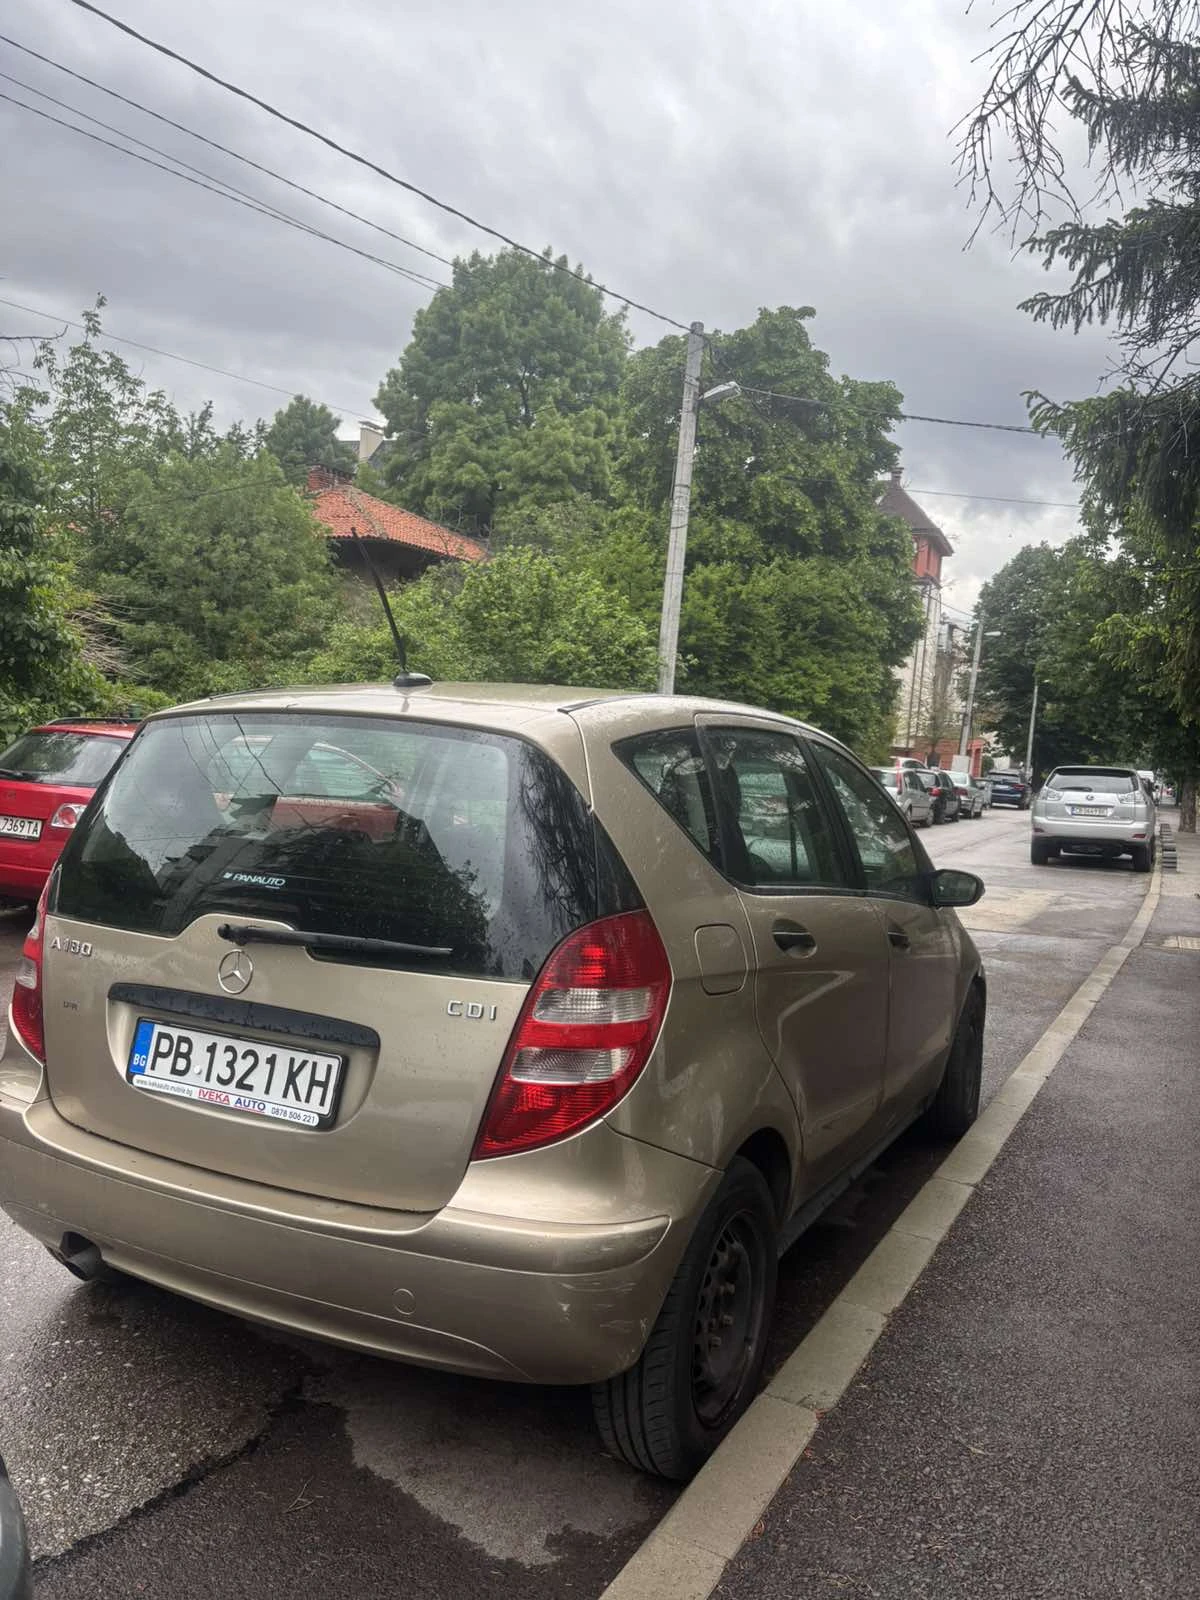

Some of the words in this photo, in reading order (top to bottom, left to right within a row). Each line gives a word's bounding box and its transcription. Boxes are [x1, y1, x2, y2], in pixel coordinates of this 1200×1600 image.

[1, 817, 26, 833] 7369
[233, 873, 286, 886] PANAUTO
[447, 1000, 497, 1020] CDI
[133, 1055, 146, 1067] BG
[150, 1031, 194, 1077] PB
[205, 1041, 277, 1095] 1321
[282, 1056, 333, 1107] KH
[198, 1088, 230, 1103] IVEKA
[235, 1097, 266, 1111] AUTO
[271, 1107, 288, 1117] 0878
[288, 1111, 301, 1121] 506
[302, 1115, 315, 1124] 221
